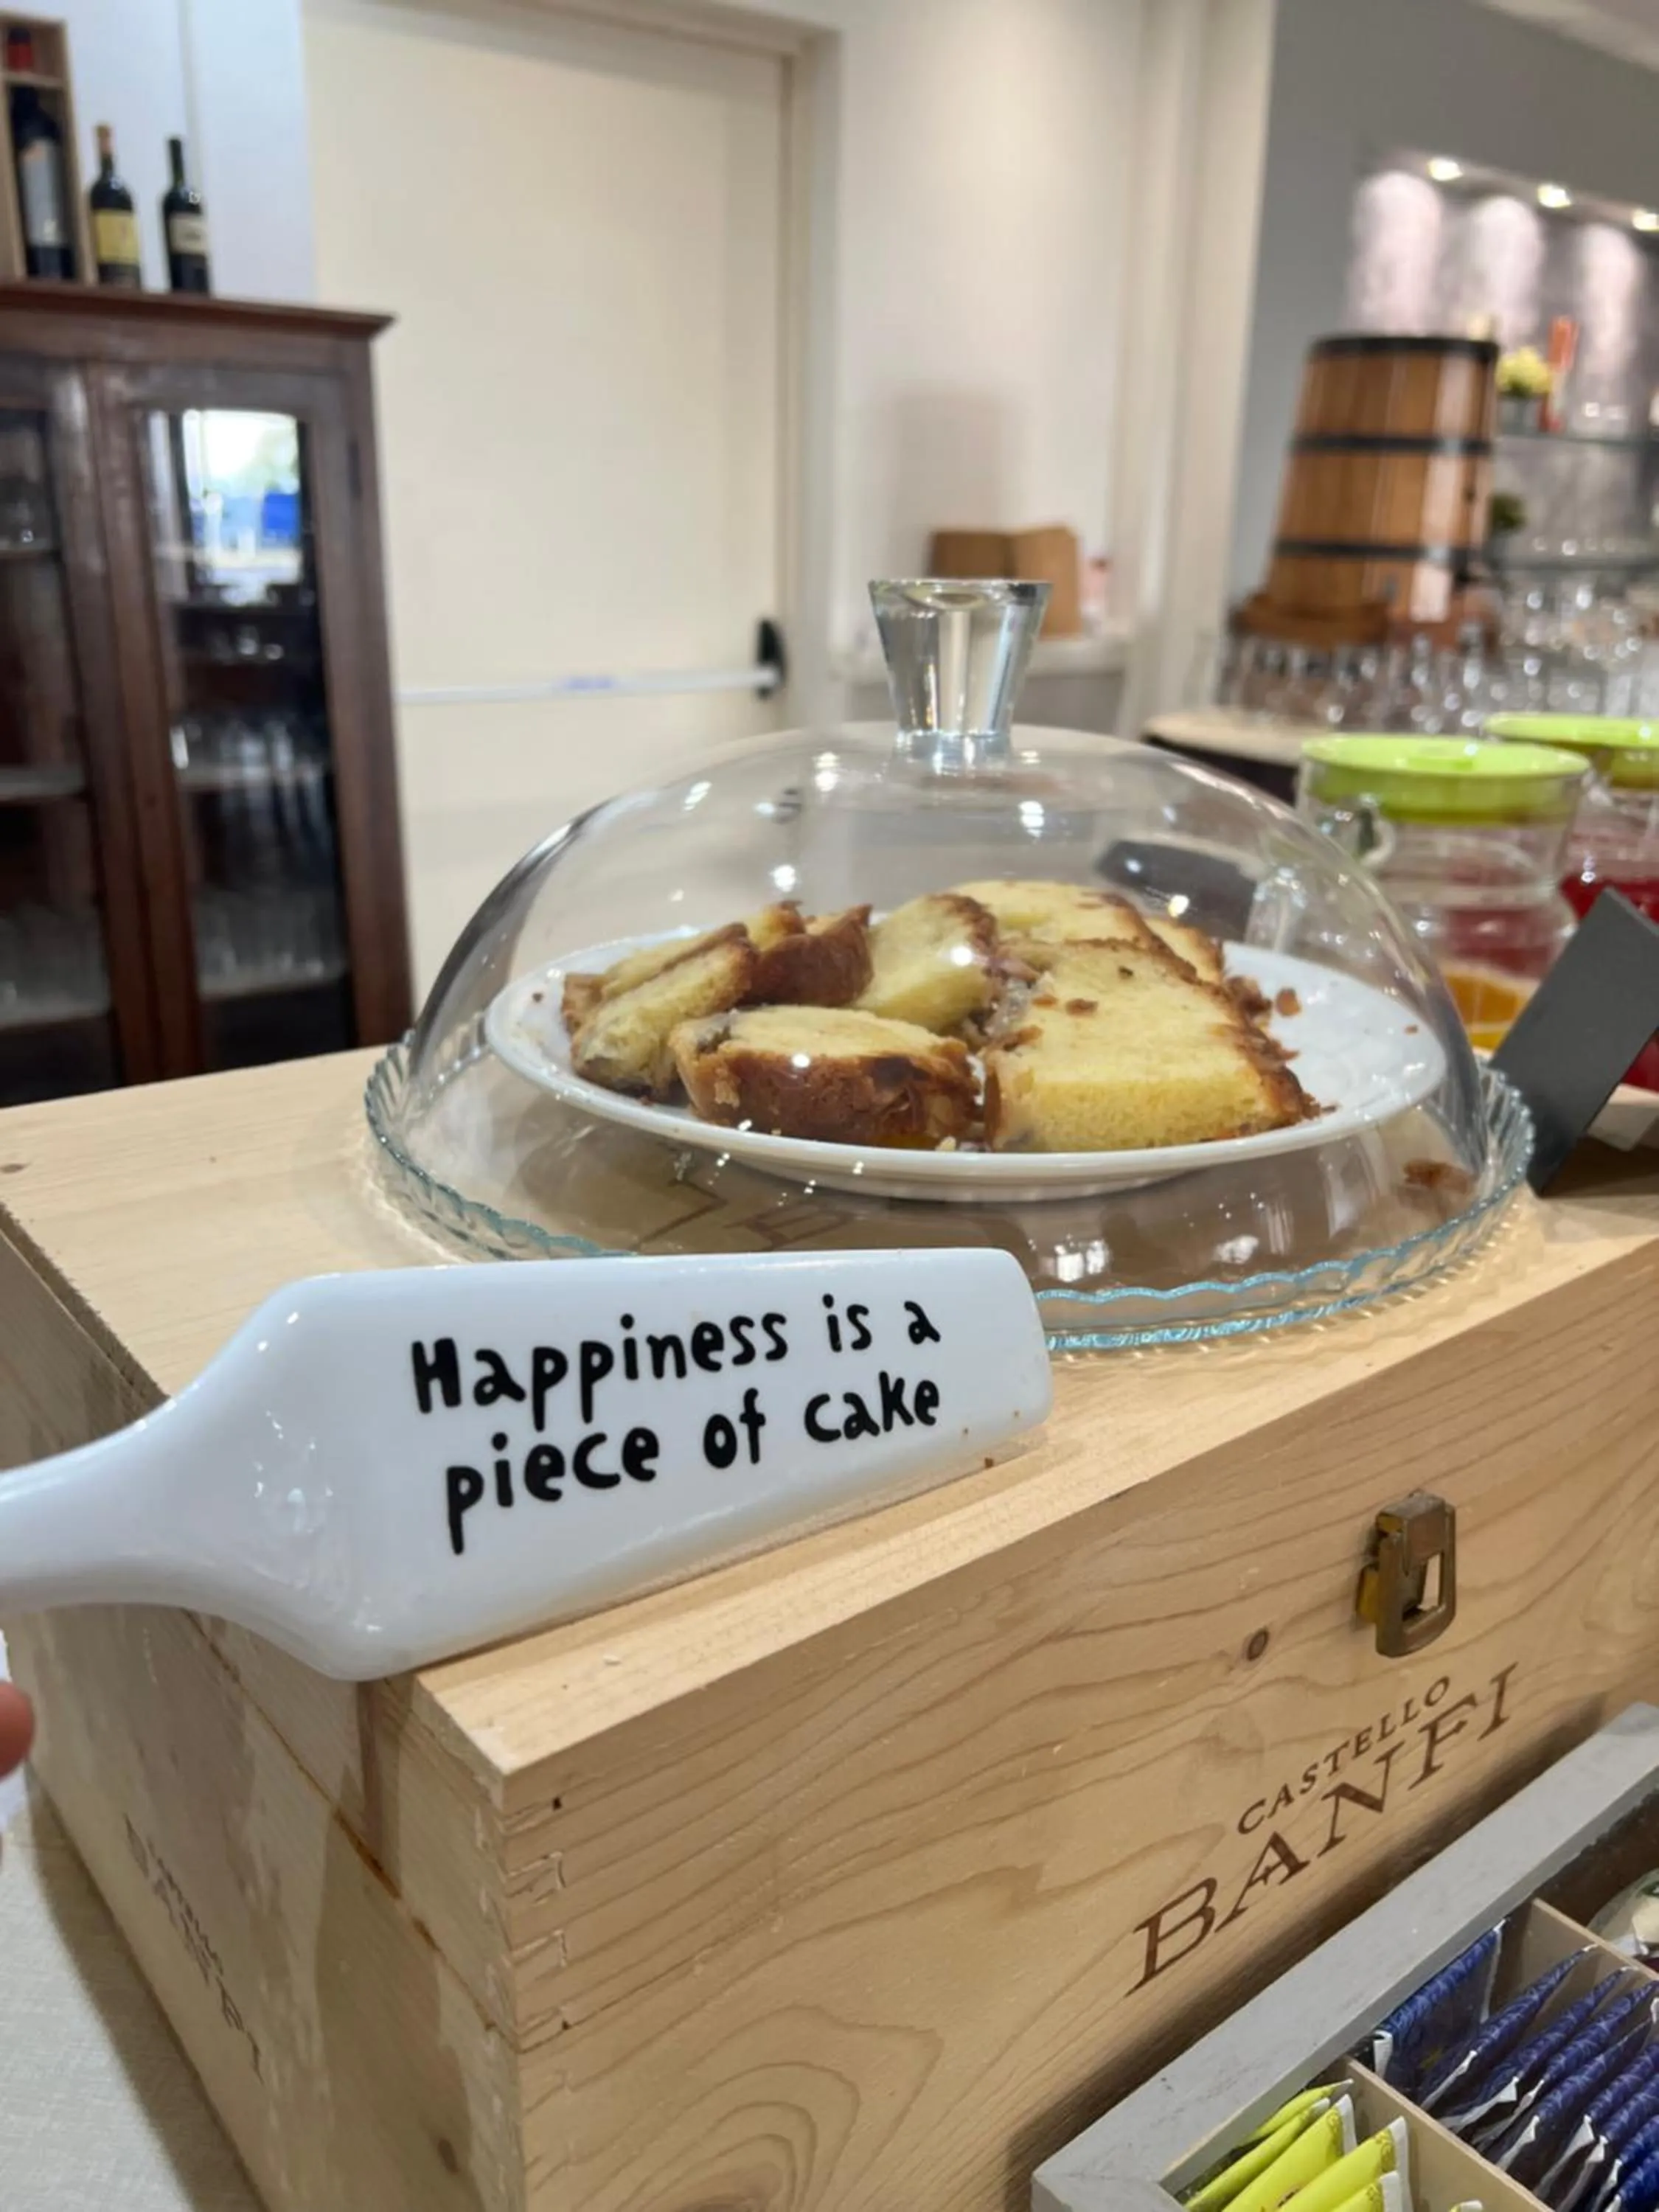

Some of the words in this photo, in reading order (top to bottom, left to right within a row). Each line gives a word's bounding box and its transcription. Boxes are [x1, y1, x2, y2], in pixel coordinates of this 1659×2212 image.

[411, 1312, 789, 1433] Happiness
[821, 1294, 872, 1353] is
[904, 1301, 942, 1346] a
[445, 1427, 660, 1555] piece
[702, 1387, 767, 1470] of
[803, 1371, 940, 1443] cake
[1124, 1662, 1520, 1997] BANFI
[1237, 1676, 1450, 1835] CASTELLO
